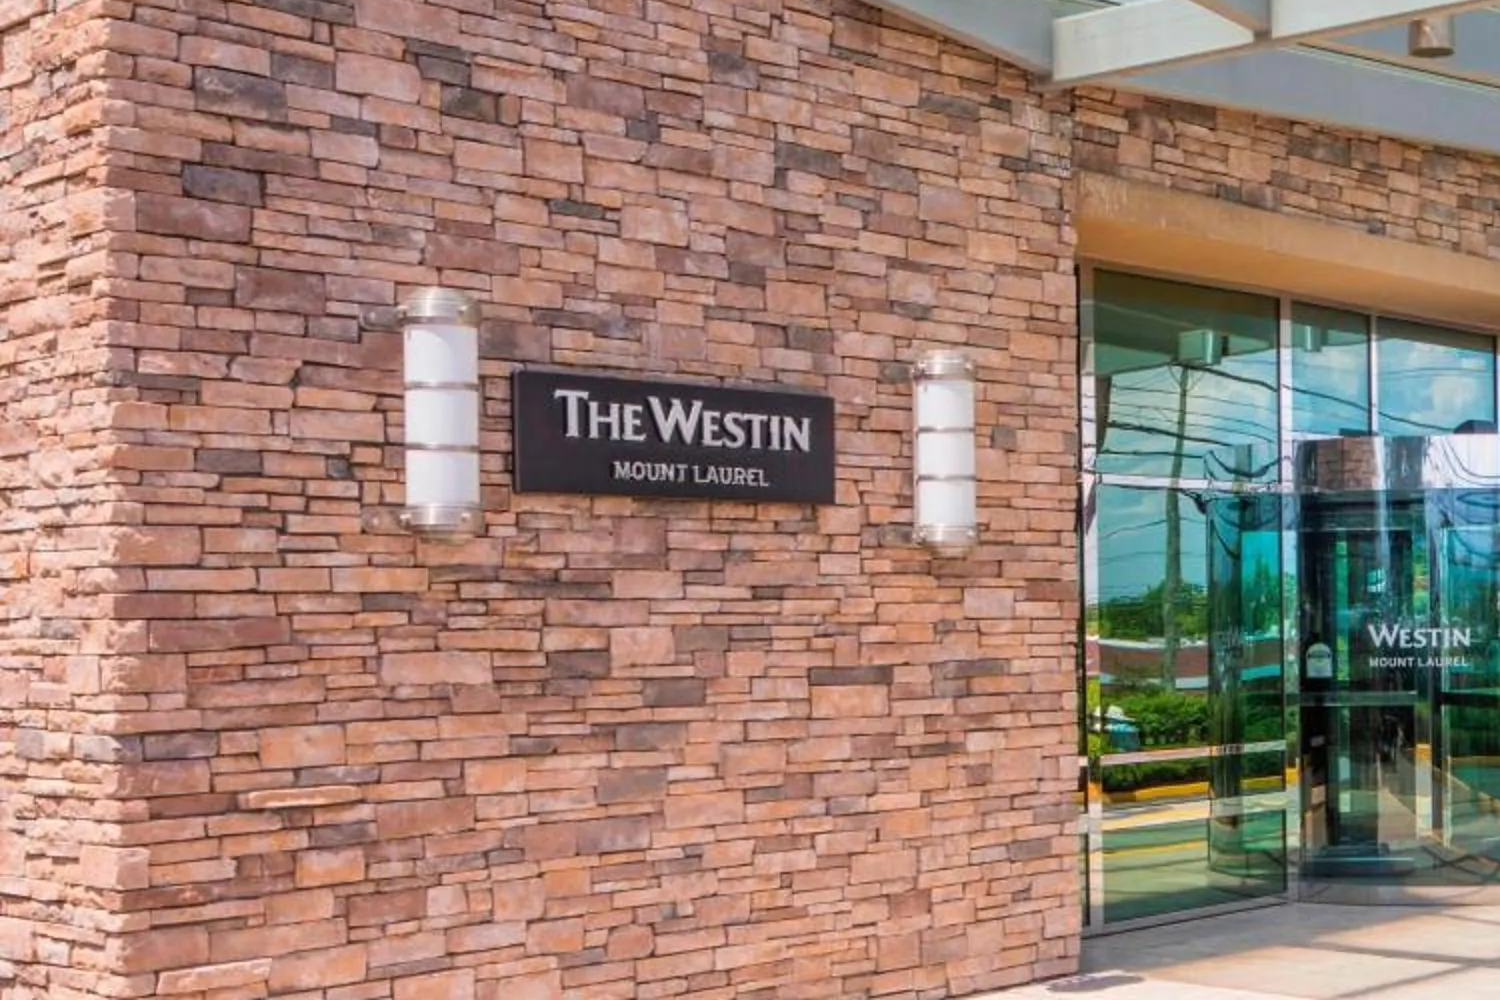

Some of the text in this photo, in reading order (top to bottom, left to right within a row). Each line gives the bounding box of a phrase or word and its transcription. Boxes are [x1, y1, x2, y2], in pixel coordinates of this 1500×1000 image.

[554, 389, 812, 452] THE WESTIN
[613, 460, 770, 487] MOUNT LAUREL
[1367, 623, 1472, 649] WESTIN
[1369, 655, 1469, 668] MOUNT LAUREL
